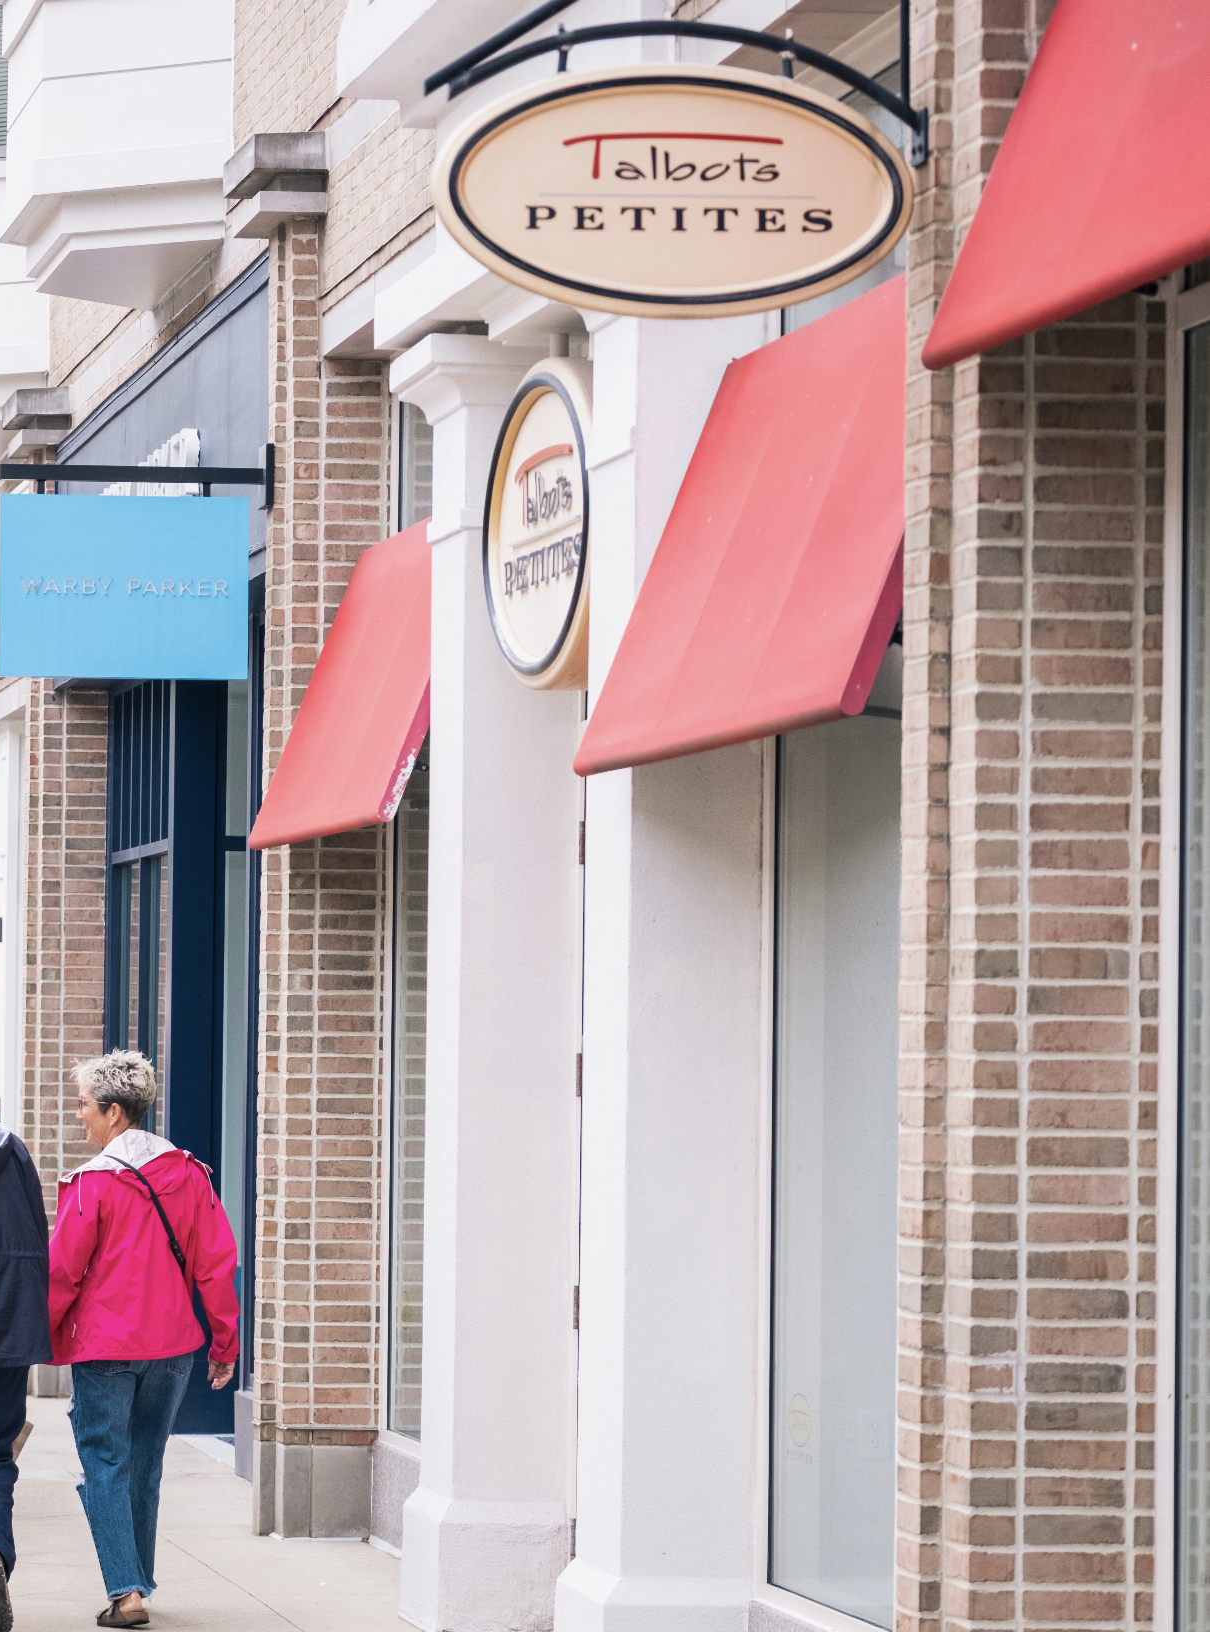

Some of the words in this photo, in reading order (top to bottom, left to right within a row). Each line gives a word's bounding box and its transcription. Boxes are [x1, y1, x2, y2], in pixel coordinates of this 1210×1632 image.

[563, 131, 784, 182] Talbots
[526, 205, 833, 234] PETITES
[515, 443, 573, 528] Talbots
[20, 576, 115, 596] WARBY
[127, 578, 230, 598] PARKER
[504, 531, 583, 596] PETITES
